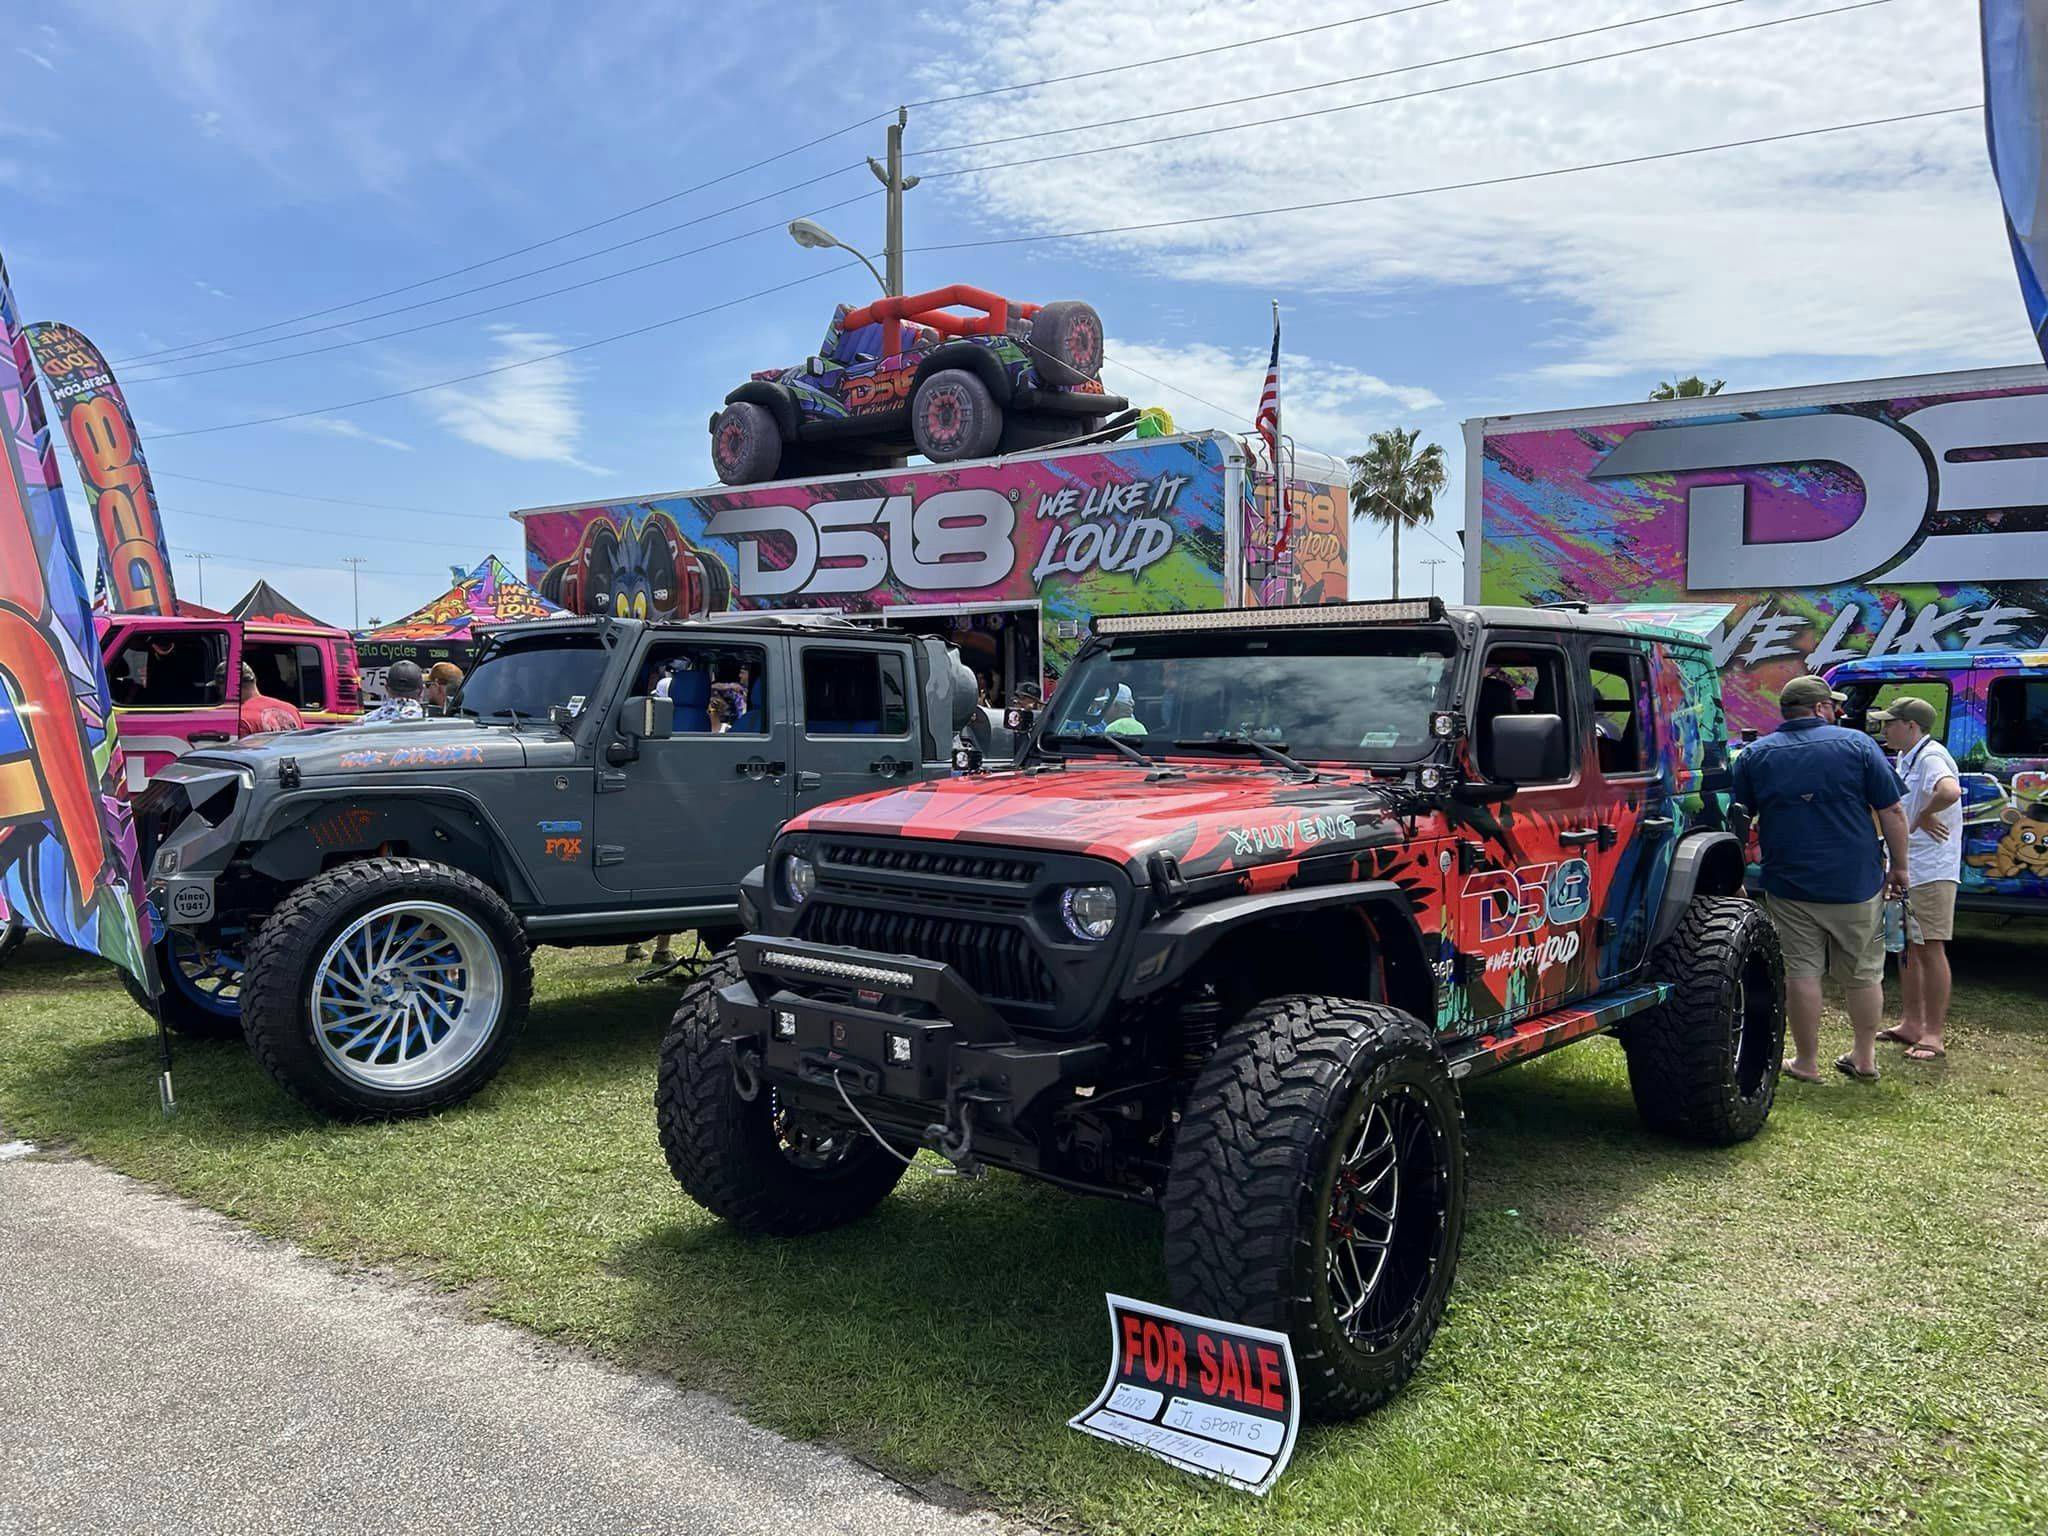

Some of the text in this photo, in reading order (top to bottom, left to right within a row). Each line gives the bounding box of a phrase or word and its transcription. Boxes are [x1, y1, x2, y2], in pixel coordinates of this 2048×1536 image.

[1037, 474, 1191, 520] WE LIKE IT
[705, 488, 1015, 597] DS18
[1032, 511, 1173, 593] LOUD
[488, 596, 522, 605] LIKE
[501, 584, 529, 595] WE
[497, 604, 551, 619] LOUD
[380, 643, 417, 660] Cycles
[1227, 814, 1357, 856] XIUYENG
[545, 838, 582, 862] FOX
[179, 893, 205, 901] since
[1461, 858, 1591, 943] DS18
[1122, 1315, 1285, 1413] FOR SALE
[1112, 1393, 1147, 1412] 2018
[1174, 1409, 1194, 1430] JL
[1200, 1416, 1245, 1437] SPORT
